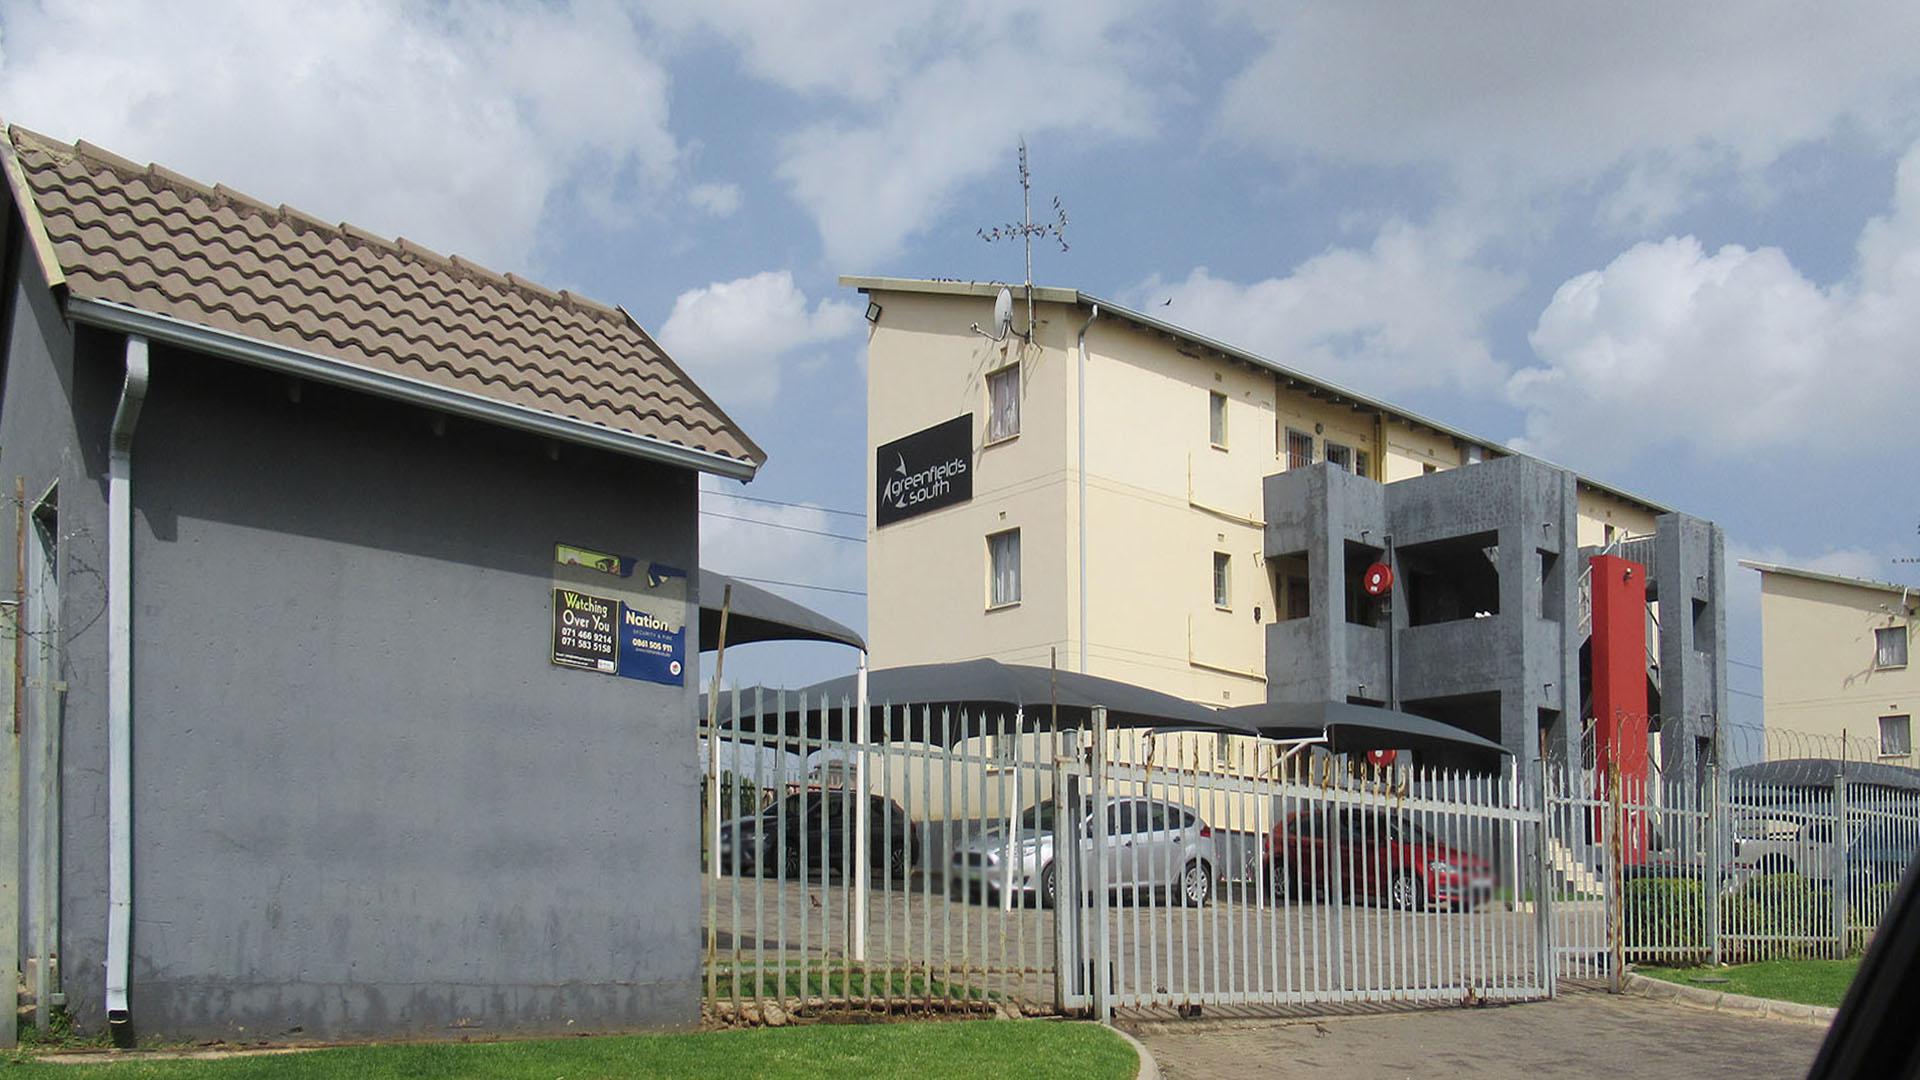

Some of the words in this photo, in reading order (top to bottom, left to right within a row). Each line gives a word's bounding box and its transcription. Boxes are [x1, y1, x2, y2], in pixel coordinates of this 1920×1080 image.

[891, 458, 967, 497] greenfields
[909, 479, 950, 505] south
[564, 592, 608, 618] Watching
[563, 609, 590, 628] Over
[592, 615, 610, 632] You
[561, 627, 576, 637] 071
[593, 633, 612, 644] 9214
[561, 637, 576, 647] 071
[578, 640, 592, 650] 583
[593, 643, 611, 653] 5158
